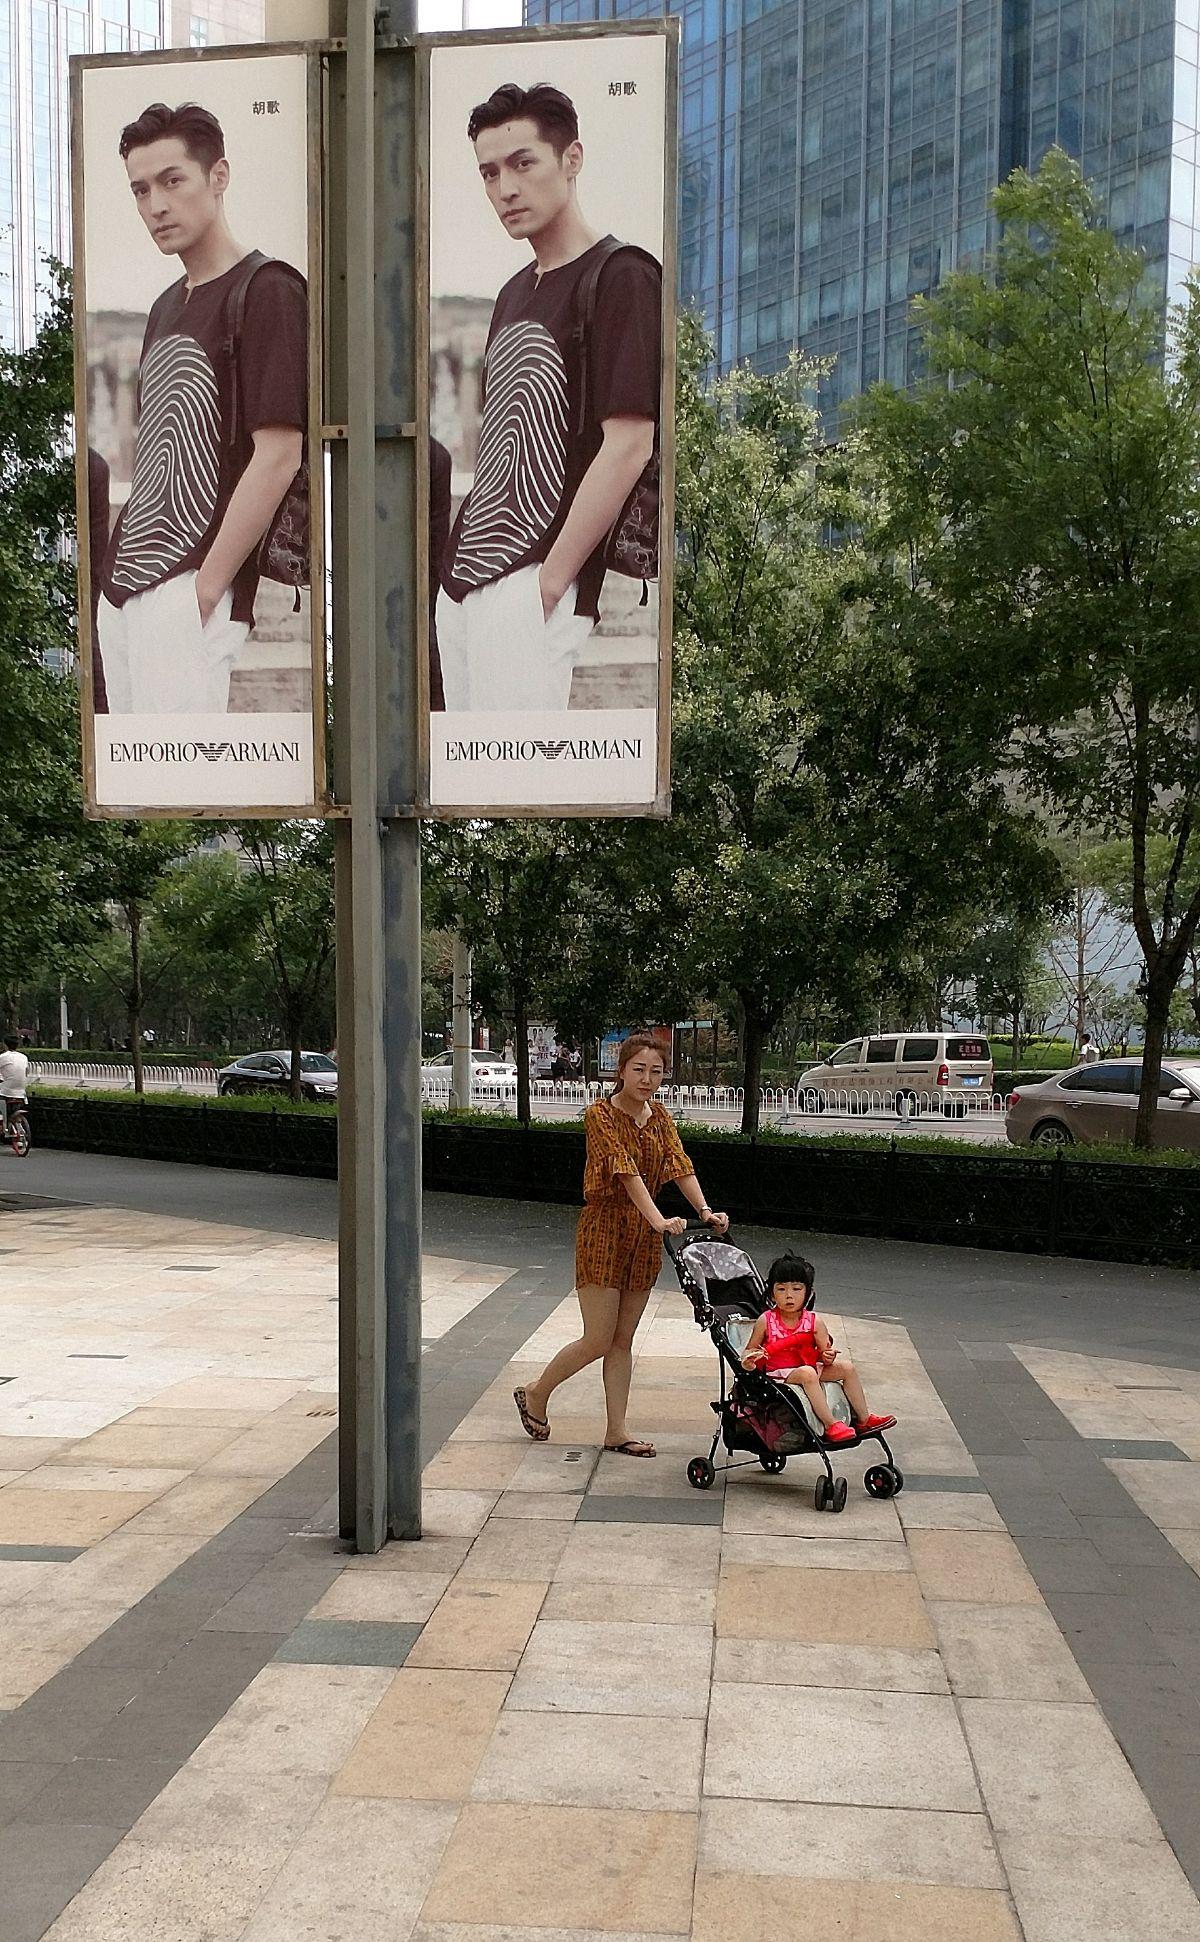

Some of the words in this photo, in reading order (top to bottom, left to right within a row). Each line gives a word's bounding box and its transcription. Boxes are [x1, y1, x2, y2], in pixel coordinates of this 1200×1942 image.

[608, 81, 637, 96] 胡歌
[252, 100, 280, 115] 胡歌
[110, 742, 197, 762] EMPORIO
[225, 742, 300, 762] ARMANI
[446, 740, 536, 761] EMPORIO
[564, 739, 641, 760] ARMANI
